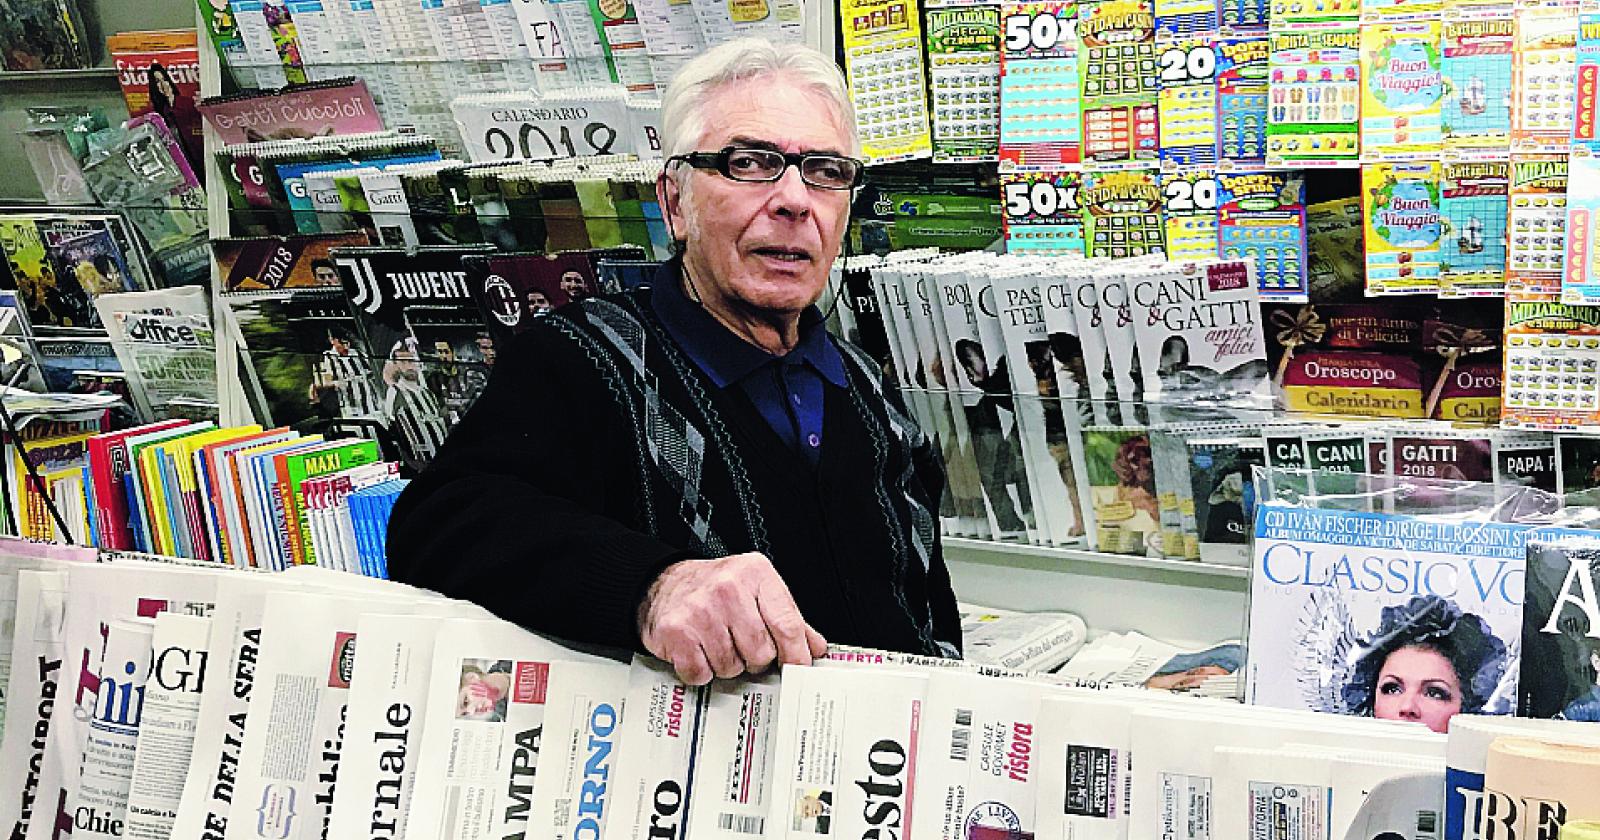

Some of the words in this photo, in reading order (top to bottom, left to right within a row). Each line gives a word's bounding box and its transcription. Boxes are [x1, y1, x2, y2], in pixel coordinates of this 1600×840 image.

[950, 26, 987, 37] MEGA
[1390, 59, 1428, 73] Buon
[215, 104, 278, 129] Gatti
[280, 97, 366, 123] Cuccioli
[491, 107, 589, 122] CALENDARIO
[484, 122, 617, 161] 2018
[1222, 174, 1284, 191] DOPPIA
[1391, 196, 1430, 211] Buon
[263, 247, 293, 288] 2018
[386, 271, 471, 299] JUVENT
[1134, 276, 1208, 308] CANI
[1163, 299, 1254, 331] GATTI
[1304, 361, 1397, 384] Oroscopo
[1305, 391, 1410, 411] Calendario
[304, 453, 341, 475] MAXI
[1316, 445, 1363, 462] CANI
[1402, 445, 1457, 462] GATTI
[1507, 455, 1544, 474] PAPA
[1403, 464, 1435, 477] 2018
[1265, 510, 1285, 528] CD
[1325, 515, 1382, 536] FISCHER
[1385, 520, 1436, 540] DIRIGE
[1453, 525, 1509, 547] ROSSINI
[1263, 543, 1458, 598] CLASSIC
[213, 712, 248, 805] DELLA
[233, 628, 262, 703] SERA
[664, 685, 687, 738] ristora
[1004, 721, 1034, 783] ristora
